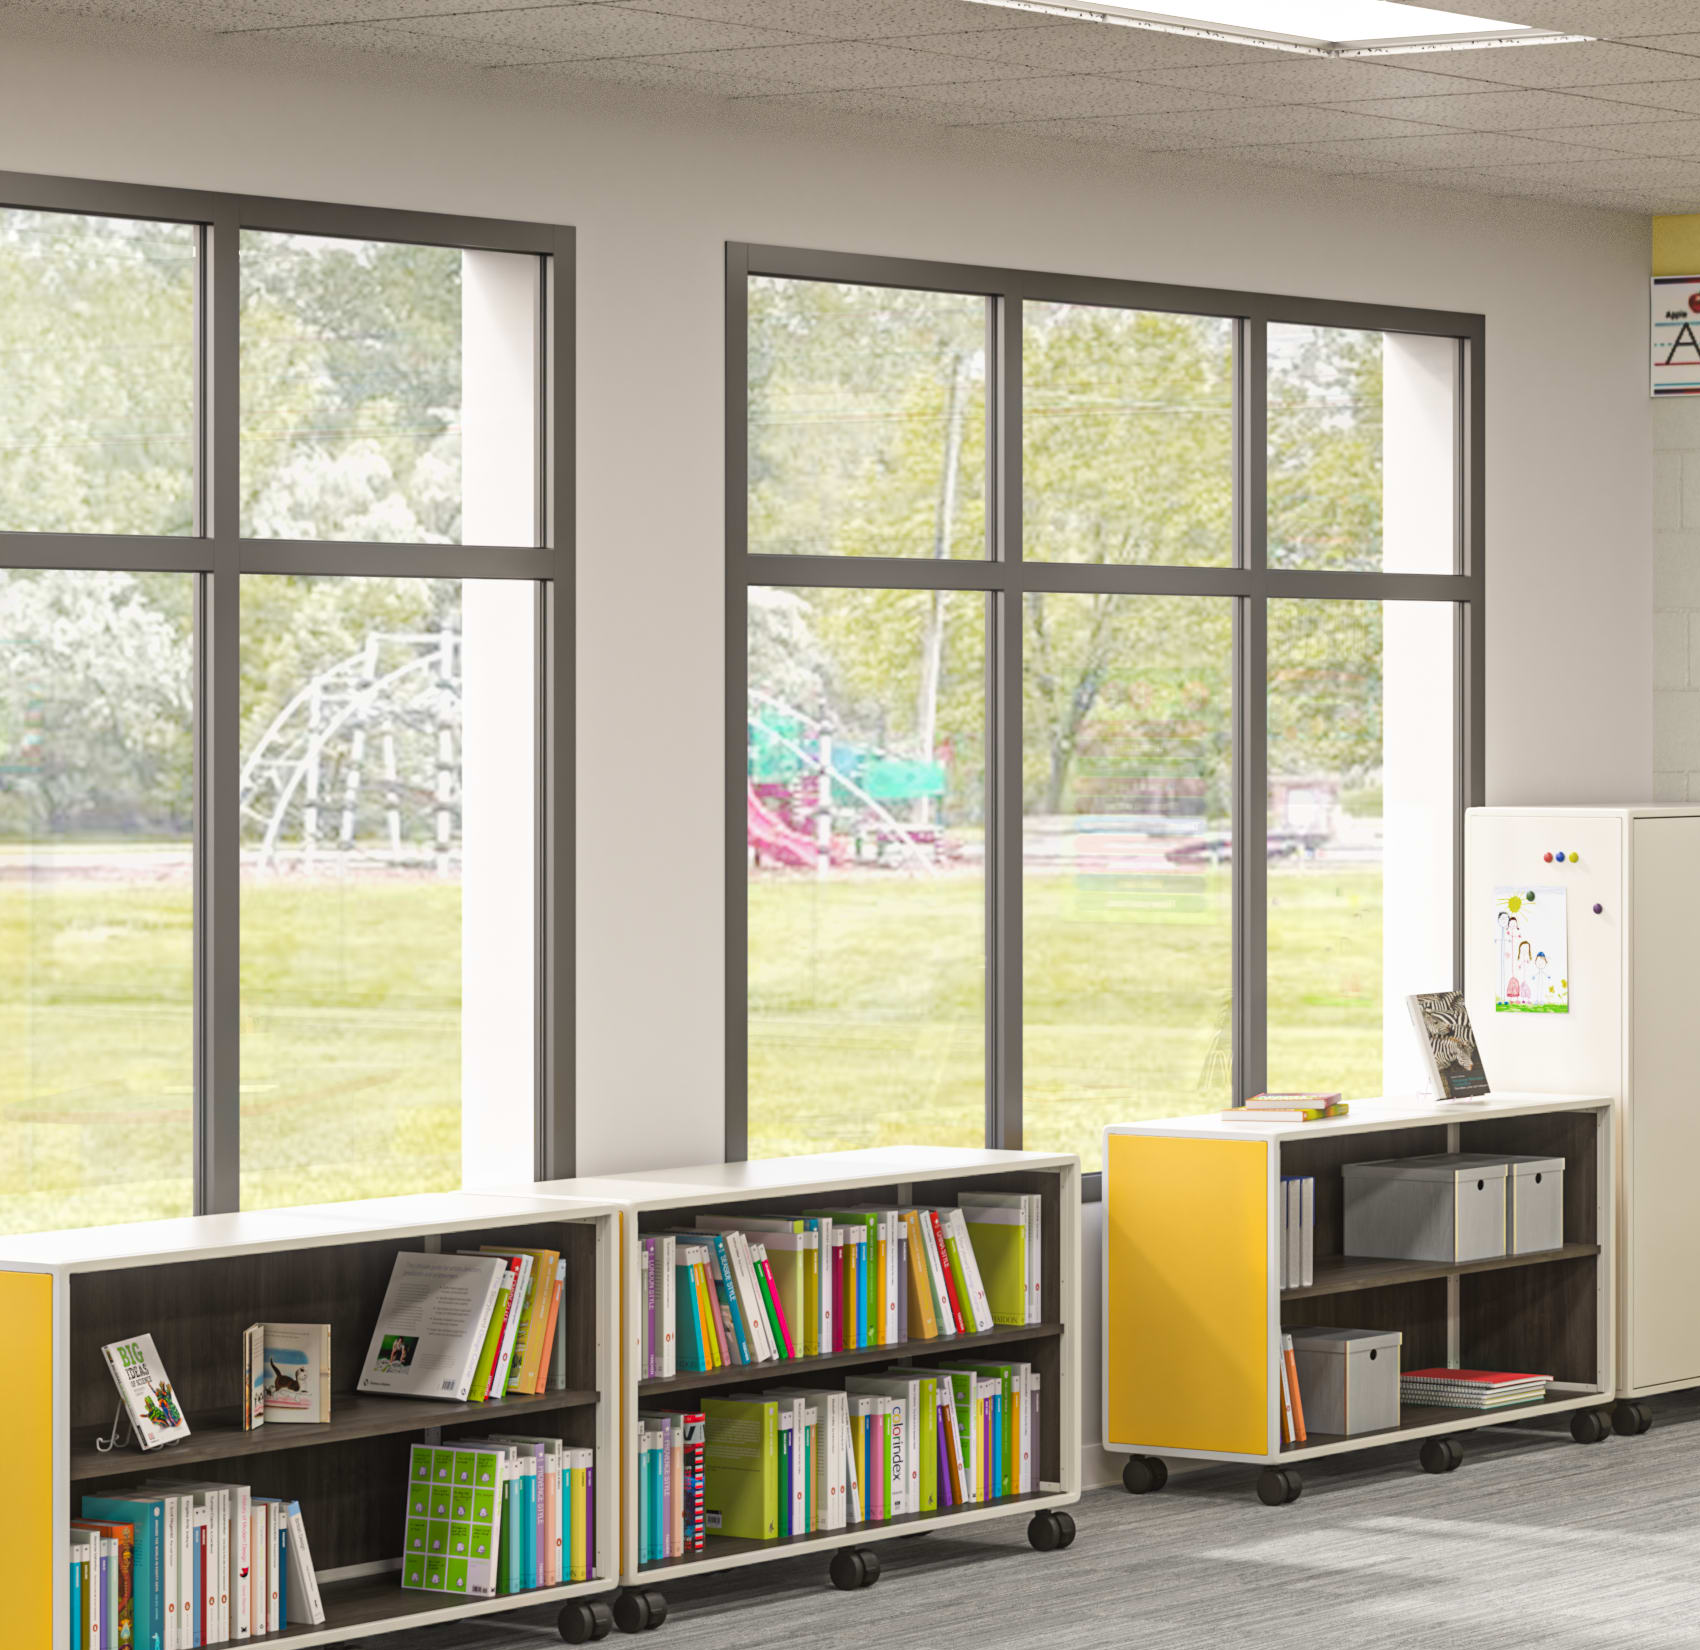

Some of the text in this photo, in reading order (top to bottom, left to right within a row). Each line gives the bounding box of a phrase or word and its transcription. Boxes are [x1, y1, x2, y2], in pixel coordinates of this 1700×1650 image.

[1665, 310, 1688, 321] Apple
[117, 1342, 144, 1367] BIG
[125, 1363, 150, 1380] IDEAS
[892, 1406, 904, 1481] colorindex
